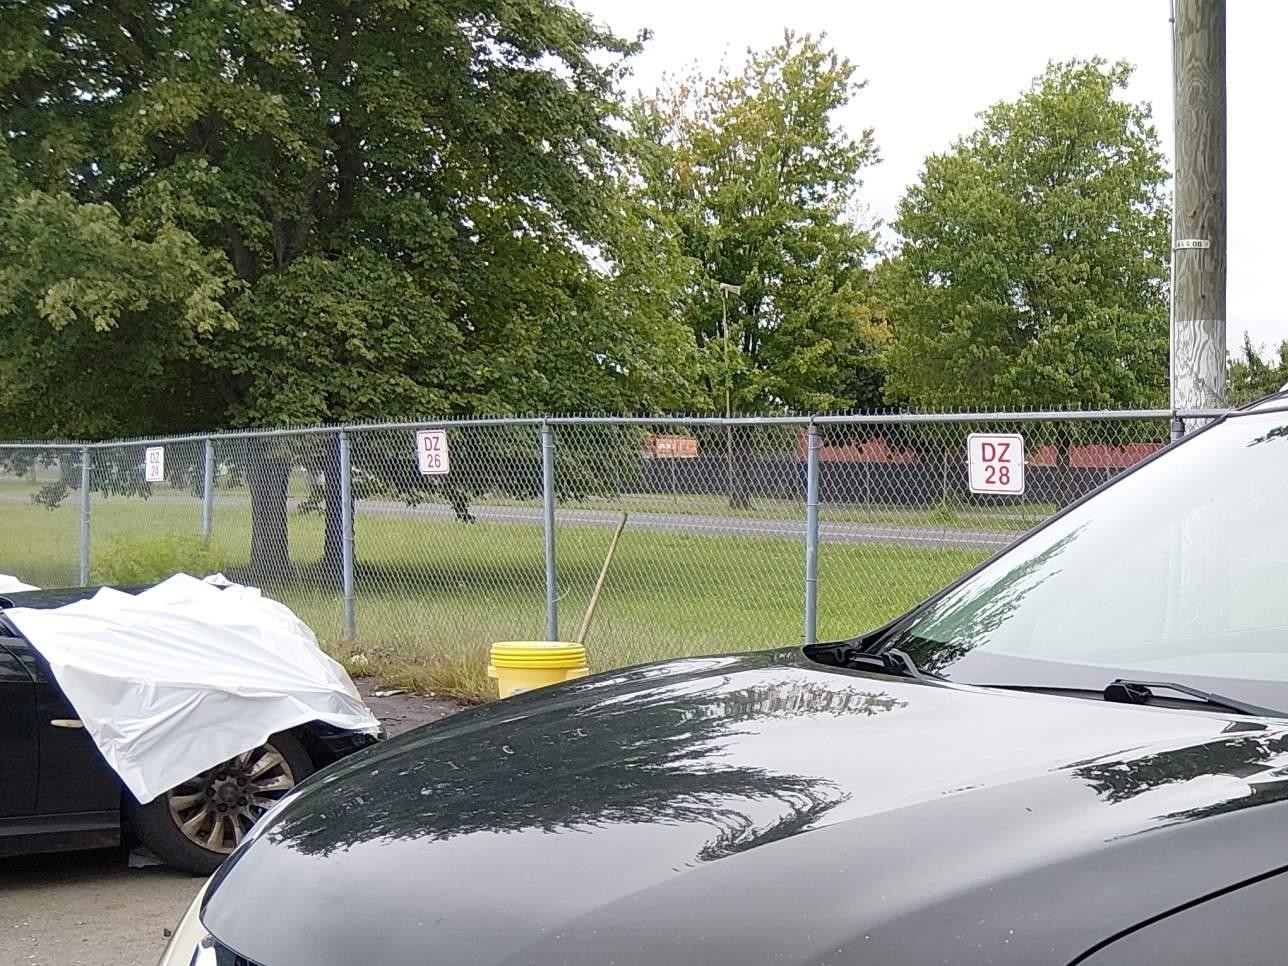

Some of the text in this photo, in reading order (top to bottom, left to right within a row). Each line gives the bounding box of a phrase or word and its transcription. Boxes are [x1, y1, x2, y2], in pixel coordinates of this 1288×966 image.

[423, 436, 441, 451] DZ
[427, 453, 442, 468] 26
[981, 442, 1011, 463] DZ
[984, 465, 1010, 485] 28
